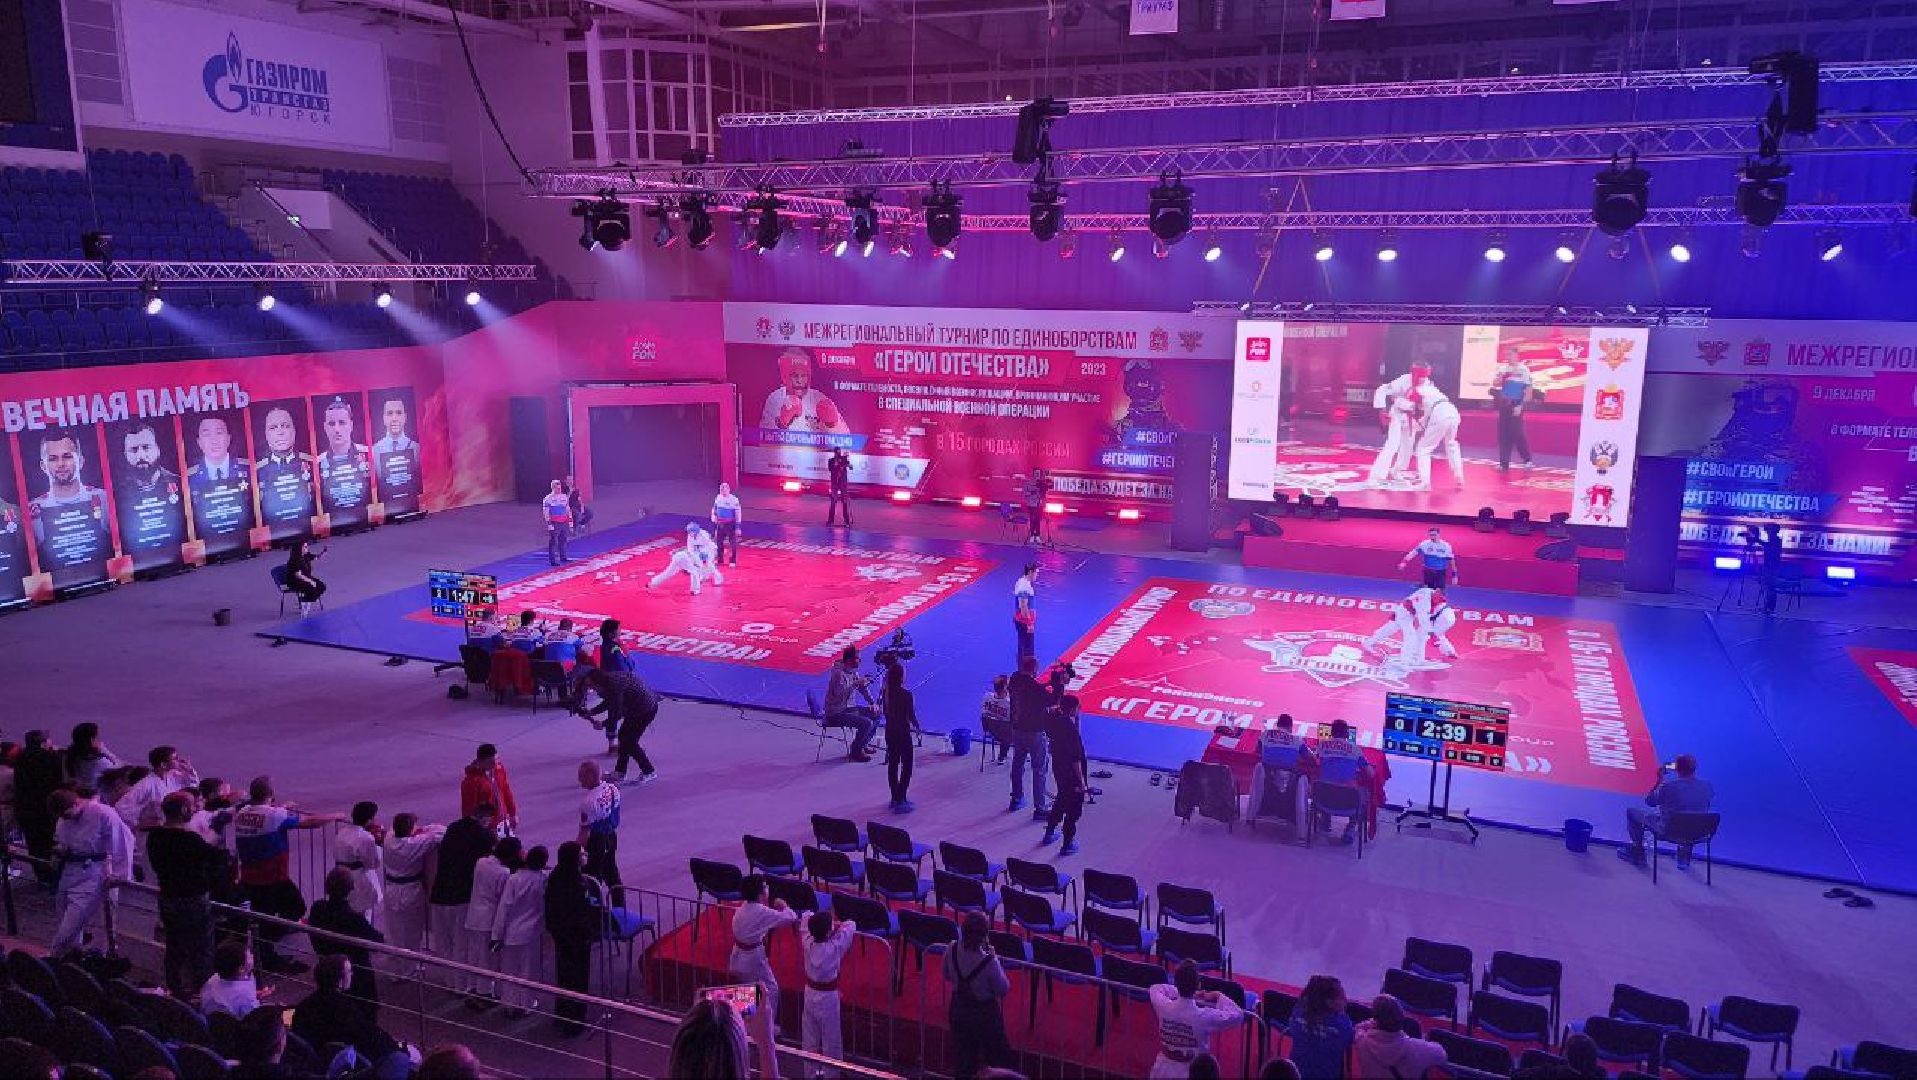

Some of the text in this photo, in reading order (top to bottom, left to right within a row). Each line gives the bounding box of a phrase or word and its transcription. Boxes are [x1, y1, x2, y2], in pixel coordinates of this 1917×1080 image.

[246, 58, 328, 95] ГАЗПРОМ
[250, 103, 330, 124] ЮГОРСК
[804, 322, 1137, 350] МЕЖРЕГИОНАЛЬНЫЙ ТУРНИР ПО ЕДИНОБОРСТВАМ
[874, 350, 1050, 379] «ГЕРОИ ОТЕЧЕСТВА»
[1081, 362, 1106, 376] 2023
[1813, 386, 1876, 401] 9 ДЕКАБРЯ
[4, 382, 250, 433] ВЕЧНАЯ ПАМЯТЬ
[879, 395, 1050, 419] В СПЕЦИАЛЬНОЙ ВОЕННОЙ ОПЕРАЦИИ
[936, 433, 944, 450] В
[949, 431, 965, 451] 15
[1135, 430, 1178, 445] #СВОиГ
[1839, 424, 1891, 438] ФОРМАТЕ
[1686, 461, 1774, 480] #СВОиГЕРОИ
[1053, 476, 1098, 495] ПОБЕДА
[1159, 484, 1174, 499] НА
[1683, 490, 1820, 512] #ГЕРОИОТЕЧЕСТВА
[1807, 530, 1828, 550] ЗА
[1207, 584, 1535, 627] ПО ЕДИНОБОВАМ
[1395, 719, 1404, 730] 0
[1421, 720, 1467, 742] 2:39
[1486, 732, 1494, 745] 1
